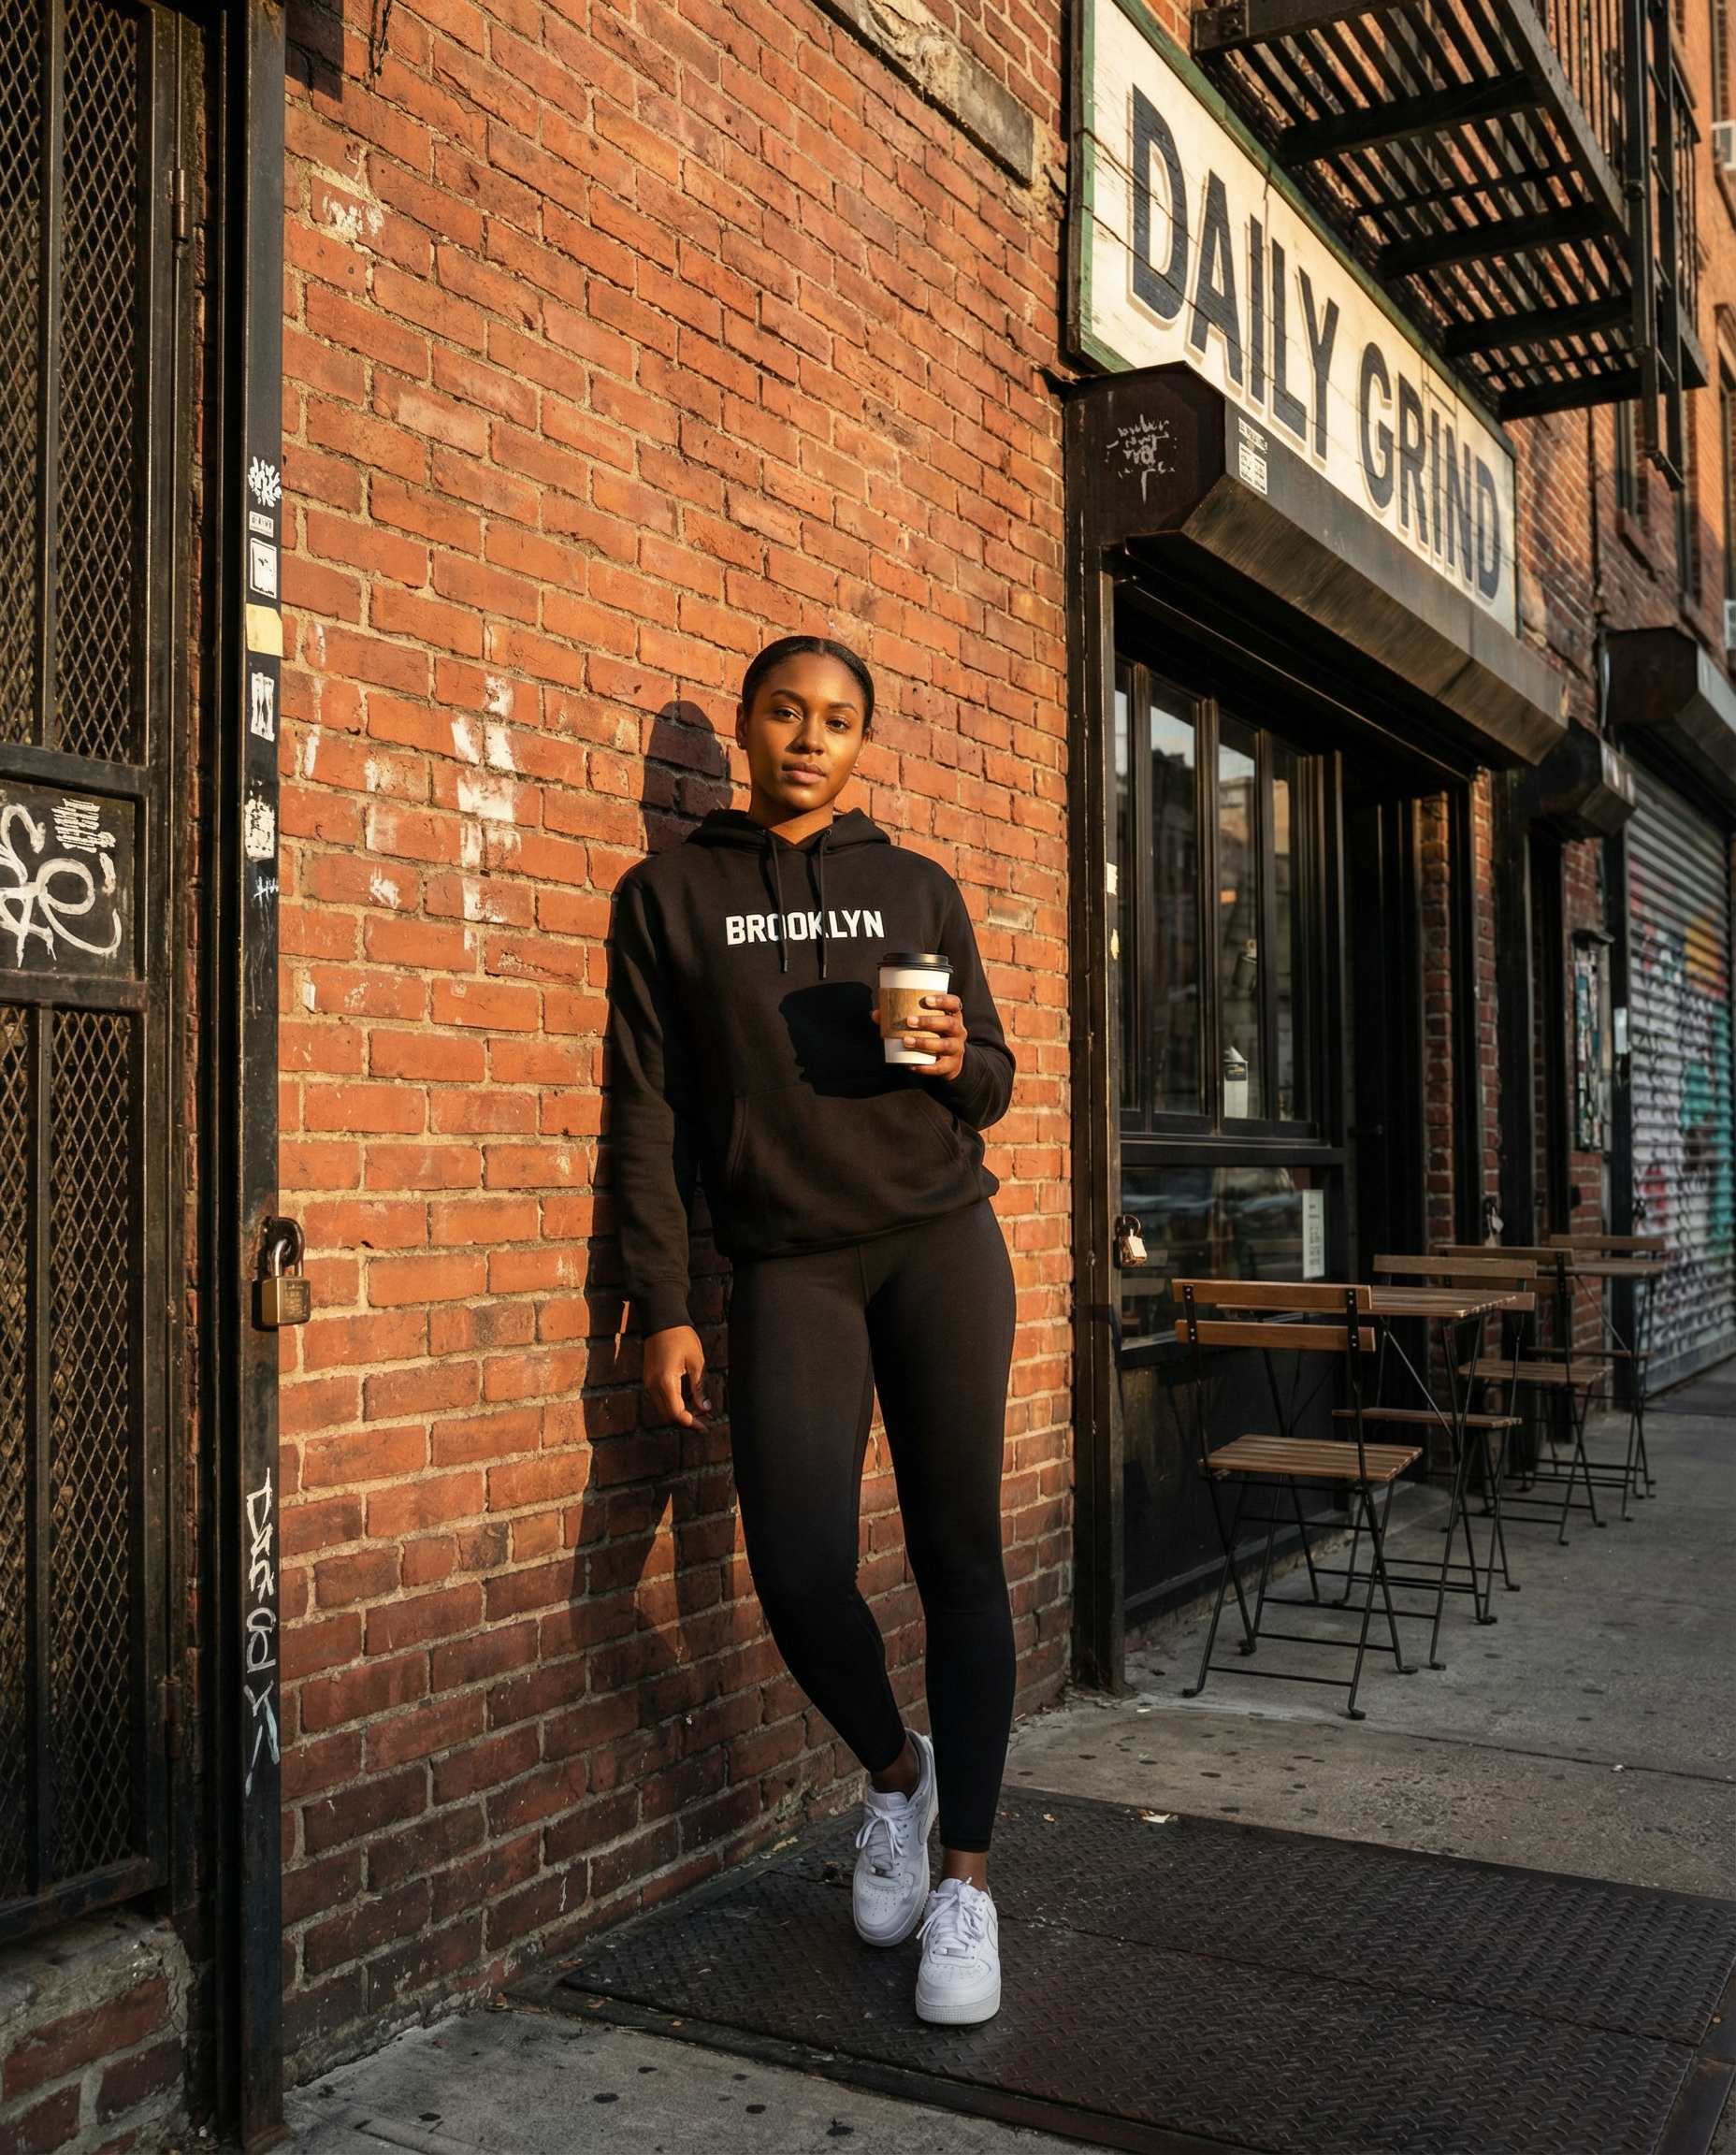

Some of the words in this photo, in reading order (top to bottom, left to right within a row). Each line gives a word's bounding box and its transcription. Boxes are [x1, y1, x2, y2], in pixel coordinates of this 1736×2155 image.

[1126, 83, 1339, 471] DAILY
[1359, 340, 1501, 611] GRIND
[725, 909, 885, 946] BROOKLYN
